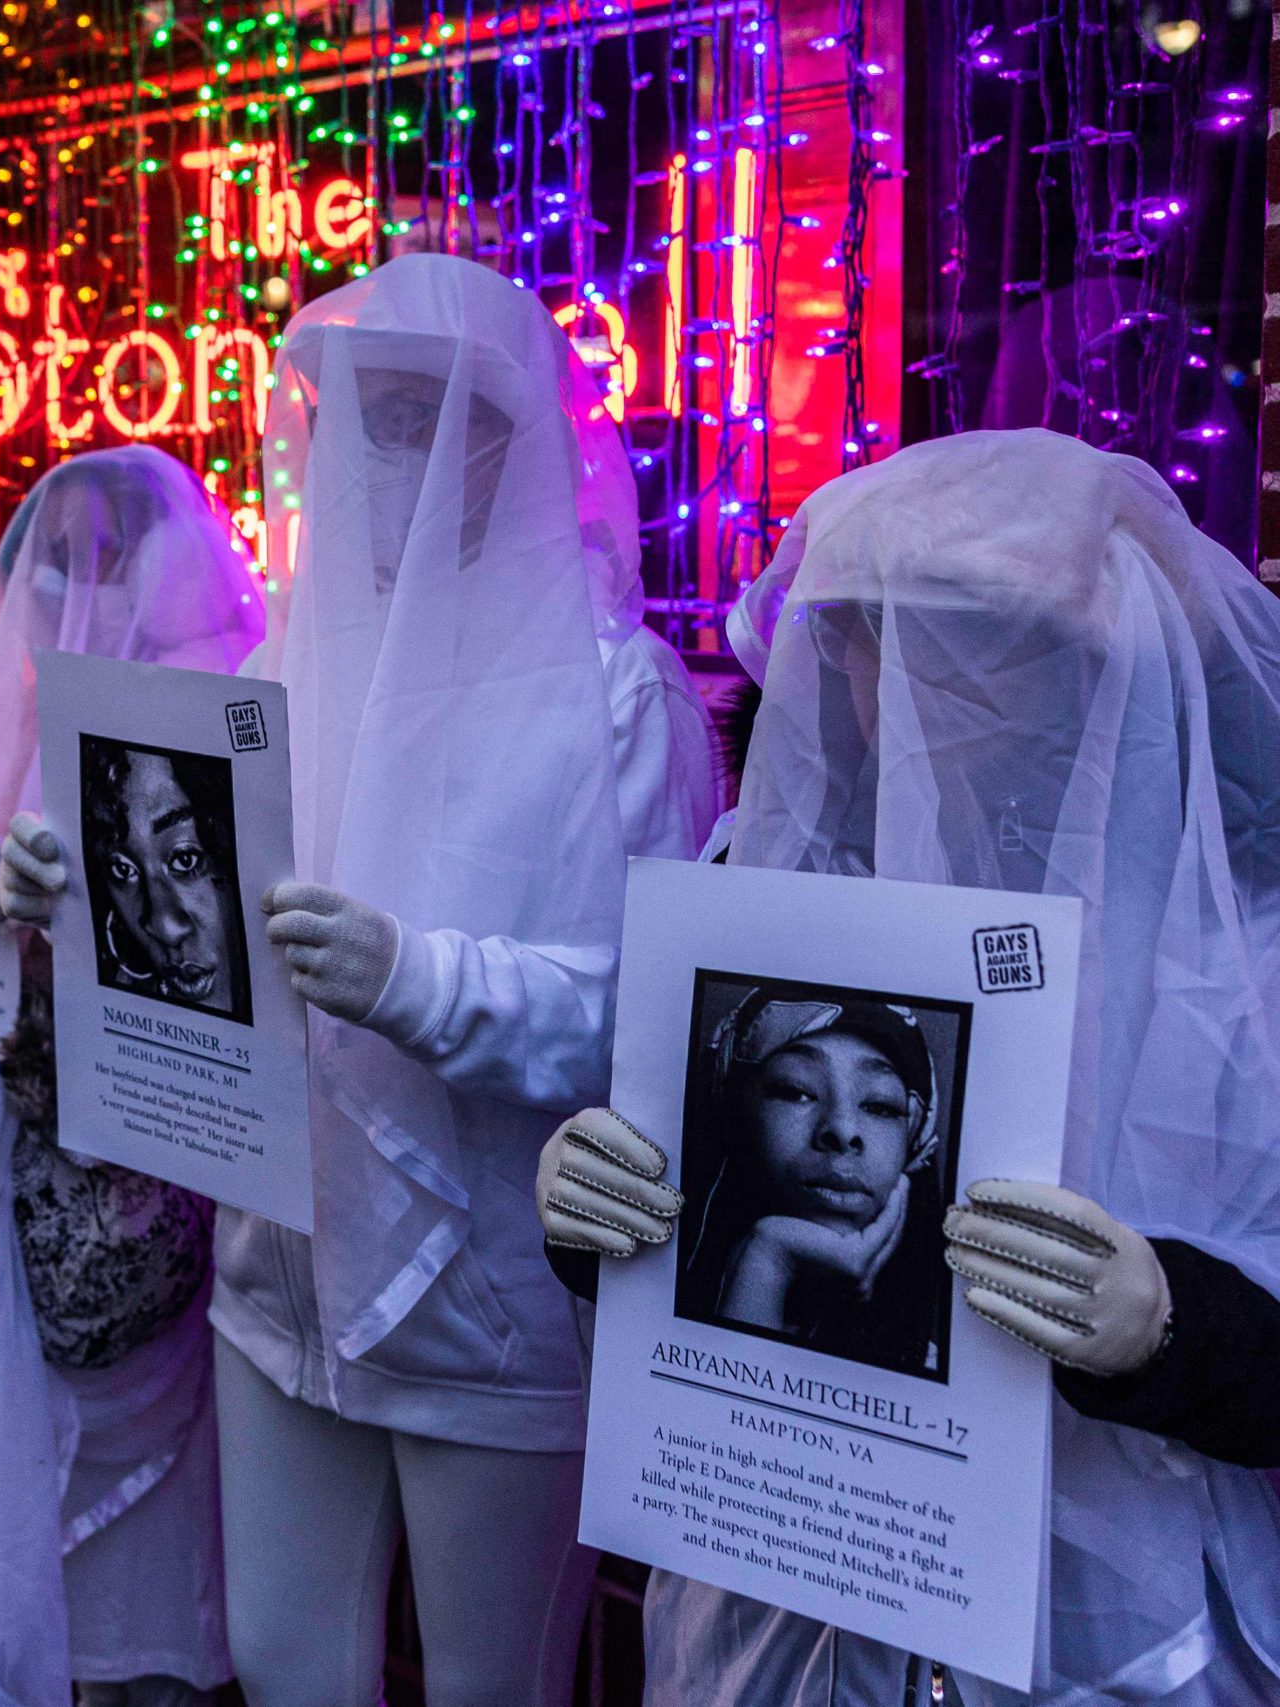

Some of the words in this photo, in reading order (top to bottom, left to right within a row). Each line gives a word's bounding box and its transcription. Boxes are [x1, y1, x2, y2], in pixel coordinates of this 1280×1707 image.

[181, 142, 371, 261] The
[231, 706, 257, 723] GAYS
[234, 721, 258, 732] AGAINST
[236, 730, 261, 747] GUNS
[983, 932, 1028, 954] GAYS
[986, 952, 1028, 967] AGAINST
[987, 964, 1032, 986] GUNS
[103, 1005, 153, 1033] NAOMI
[156, 1020, 221, 1053] SKINNER
[236, 1047, 250, 1064] 25
[95, 1061, 110, 1075] Her
[111, 1066, 149, 1086] boyfriend
[149, 1081, 164, 1091] was
[166, 1083, 196, 1101] charged
[198, 1095, 216, 1107] with
[218, 1098, 231, 1112] her
[233, 1106, 265, 1123] murder.
[117, 1043, 181, 1071] HIGHLAND
[185, 1063, 219, 1085] PARK,
[223, 1074, 239, 1090] MI
[108, 1101, 124, 1112] very
[126, 1106, 172, 1129] outstanding
[207, 1127, 223, 1142] Her
[225, 1136, 246, 1150] sister
[248, 1144, 264, 1156] said
[113, 1082, 141, 1100] Friends
[143, 1094, 157, 1105] and
[159, 1096, 183, 1115] family
[185, 1104, 222, 1126] described
[224, 1116, 237, 1130] her
[239, 1124, 247, 1134] as
[123, 1118, 153, 1136] Skinner
[154, 1127, 173, 1142] lived
[651, 1341, 776, 1391] ARIYANNA
[783, 1374, 918, 1430] MITCHELL
[947, 1418, 968, 1446] 17
[730, 1409, 840, 1456] HAMPTON,
[848, 1441, 874, 1464] VA
[653, 1425, 664, 1440] A
[668, 1430, 708, 1451] junior
[711, 1441, 724, 1457] in
[728, 1445, 757, 1468] high
[761, 1458, 804, 1480] school
[808, 1473, 833, 1490] and
[838, 1482, 845, 1493] a
[850, 1485, 909, 1512] member
[912, 1501, 930, 1517] of
[932, 1505, 956, 1525] the
[658, 1449, 696, 1473] Triple
[700, 1461, 710, 1477] E
[714, 1466, 755, 1491] Dance
[759, 1479, 823, 1514] Academy,
[827, 1500, 850, 1520] she
[855, 1511, 880, 1528] was
[884, 1517, 915, 1539] shot
[919, 1531, 947, 1549] and
[632, 1492, 639, 1504] a
[643, 1495, 678, 1517] party.
[682, 1502, 708, 1524] The
[712, 1515, 758, 1540] suspect
[762, 1532, 837, 1565] questioned
[914, 1576, 972, 1610] identity
[641, 1467, 676, 1491] killed
[680, 1481, 715, 1503] while
[718, 1494, 786, 1528] protecting
[790, 1515, 797, 1527] a
[802, 1515, 843, 1542] friend
[847, 1530, 894, 1562] during
[899, 1550, 906, 1562] a
[911, 1549, 945, 1574] fight
[950, 1564, 964, 1580] at
[683, 1531, 707, 1549] and
[711, 1537, 740, 1558] then
[744, 1547, 772, 1569] shot
[777, 1556, 799, 1577] her
[803, 1568, 862, 1597] multiple
[866, 1588, 908, 1612] times.
